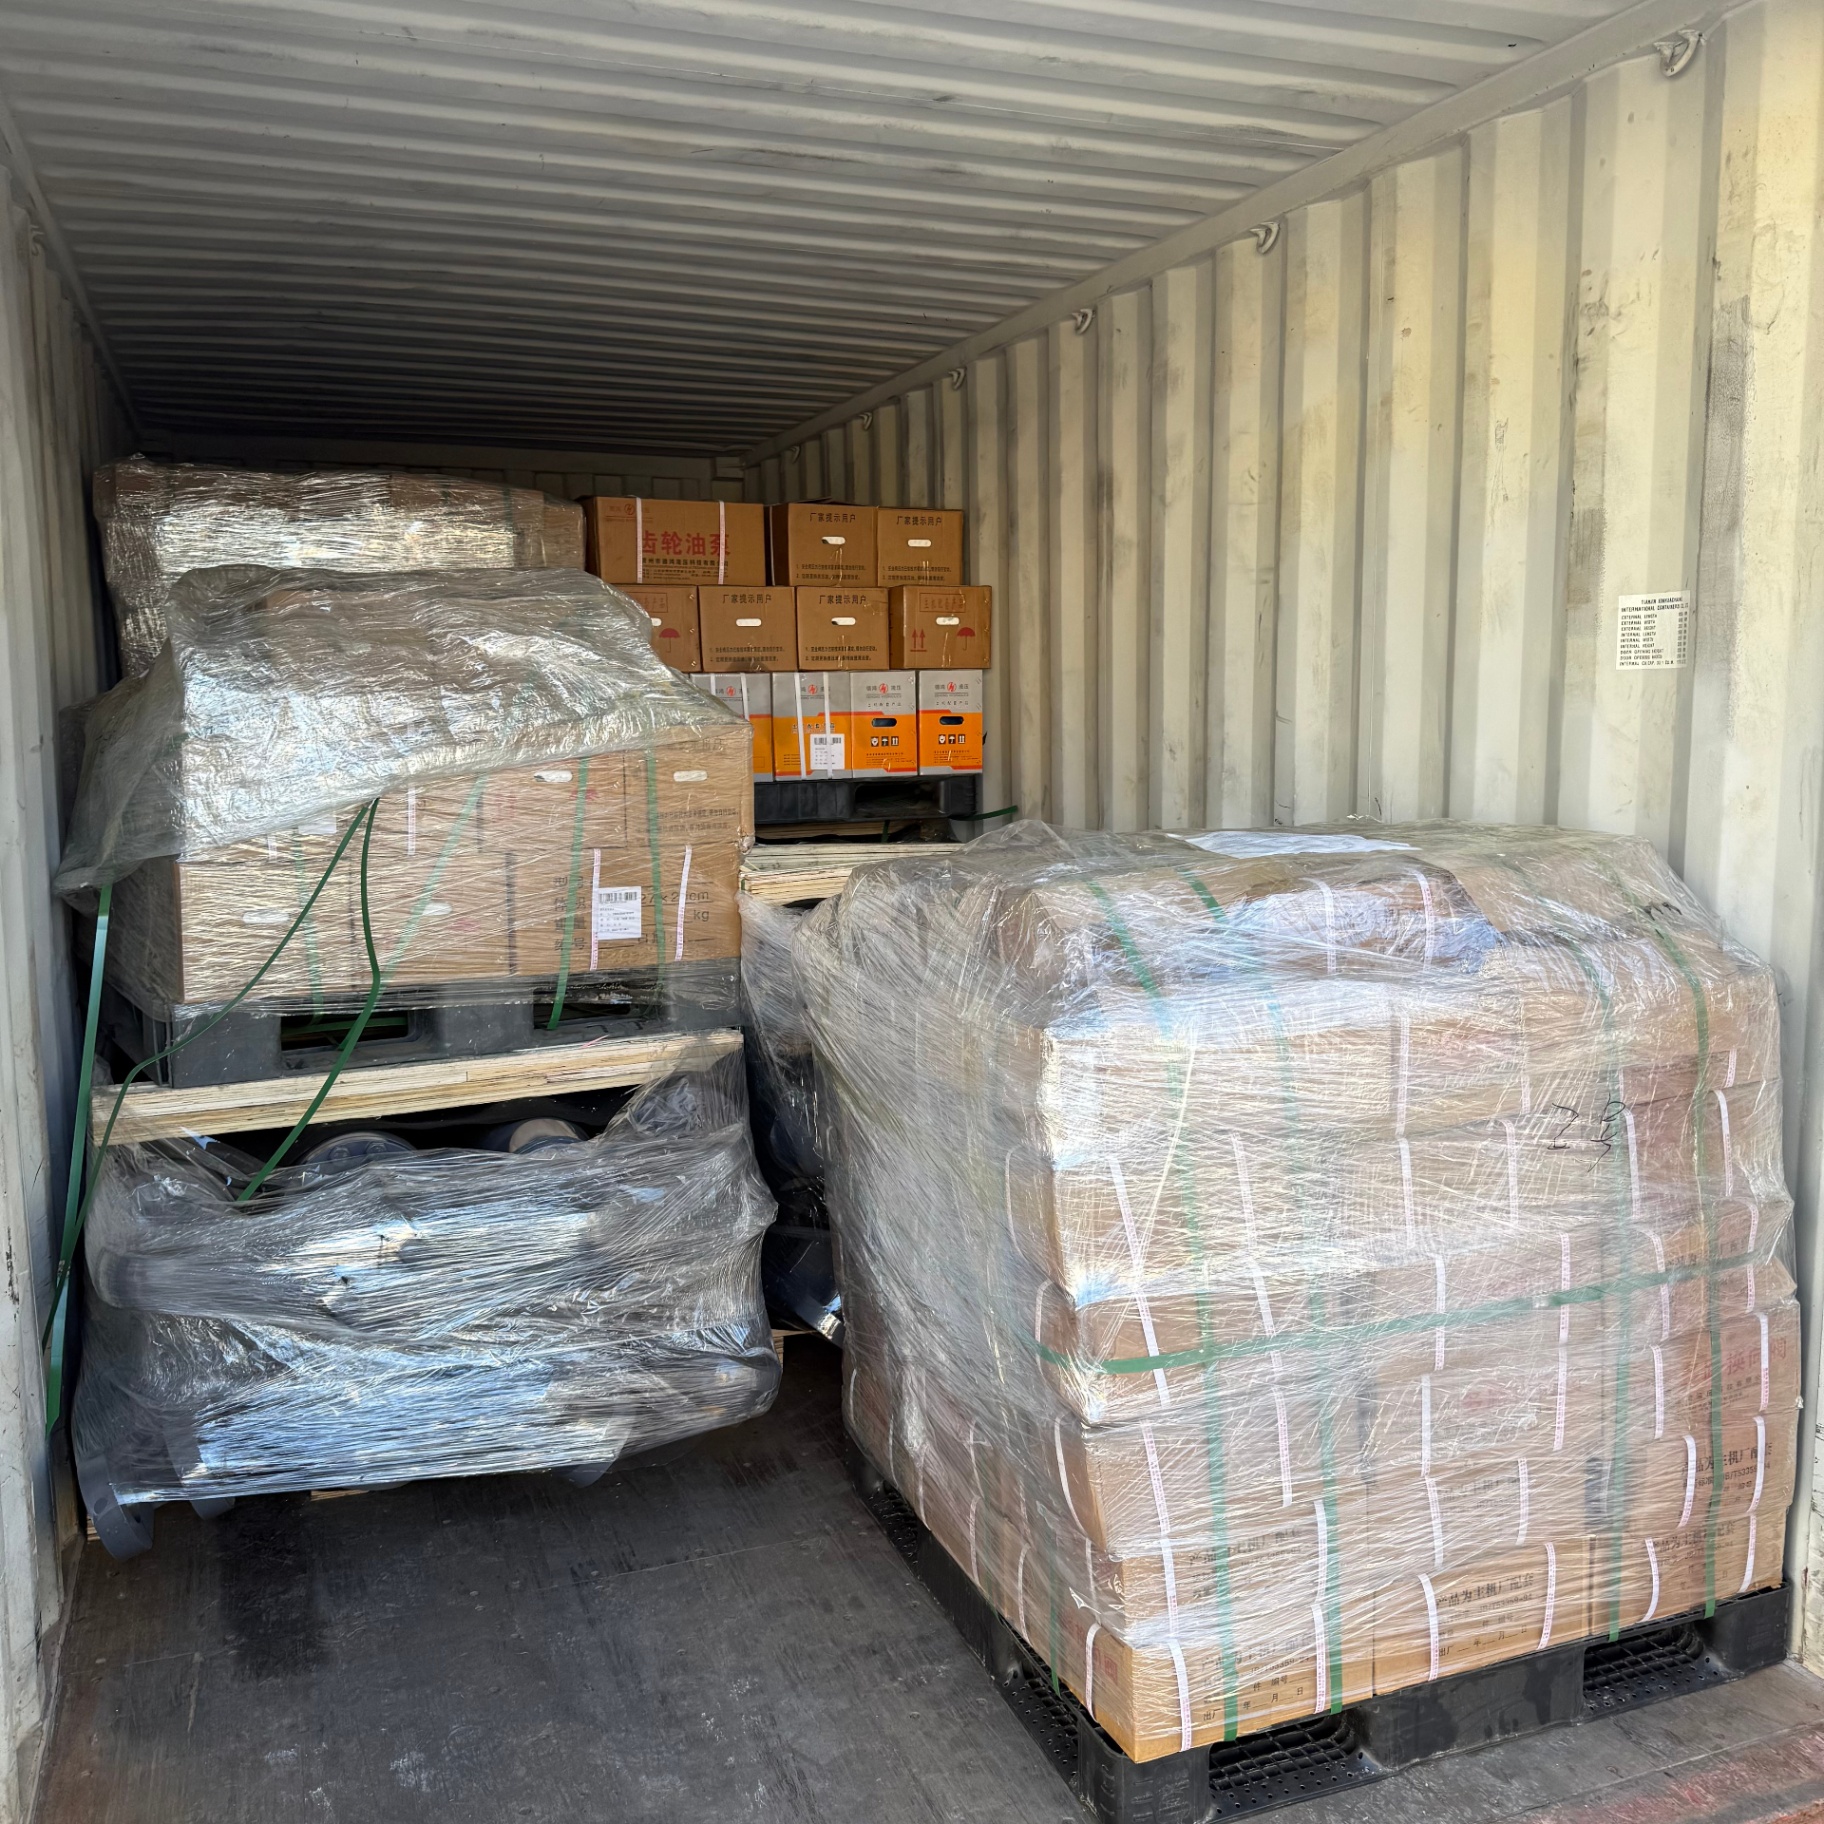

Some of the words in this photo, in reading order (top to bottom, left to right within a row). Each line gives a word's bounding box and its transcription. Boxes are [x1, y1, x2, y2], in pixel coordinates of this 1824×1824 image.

[810, 512, 857, 523] 厂家提示用户
[896, 515, 943, 526] 厂家提示用户
[642, 529, 731, 556] 齿轮油泵
[722, 594, 773, 605] 厂家提示用户
[819, 594, 868, 605] 厂家提示用户
[693, 909, 710, 922] kg
[1271, 1675, 1289, 1687] 编号
[1203, 1708, 1222, 1721] 出厂
[1243, 1701, 1252, 1710] 年
[1271, 1692, 1279, 1704] 月
[1296, 1686, 1304, 1696] 日
